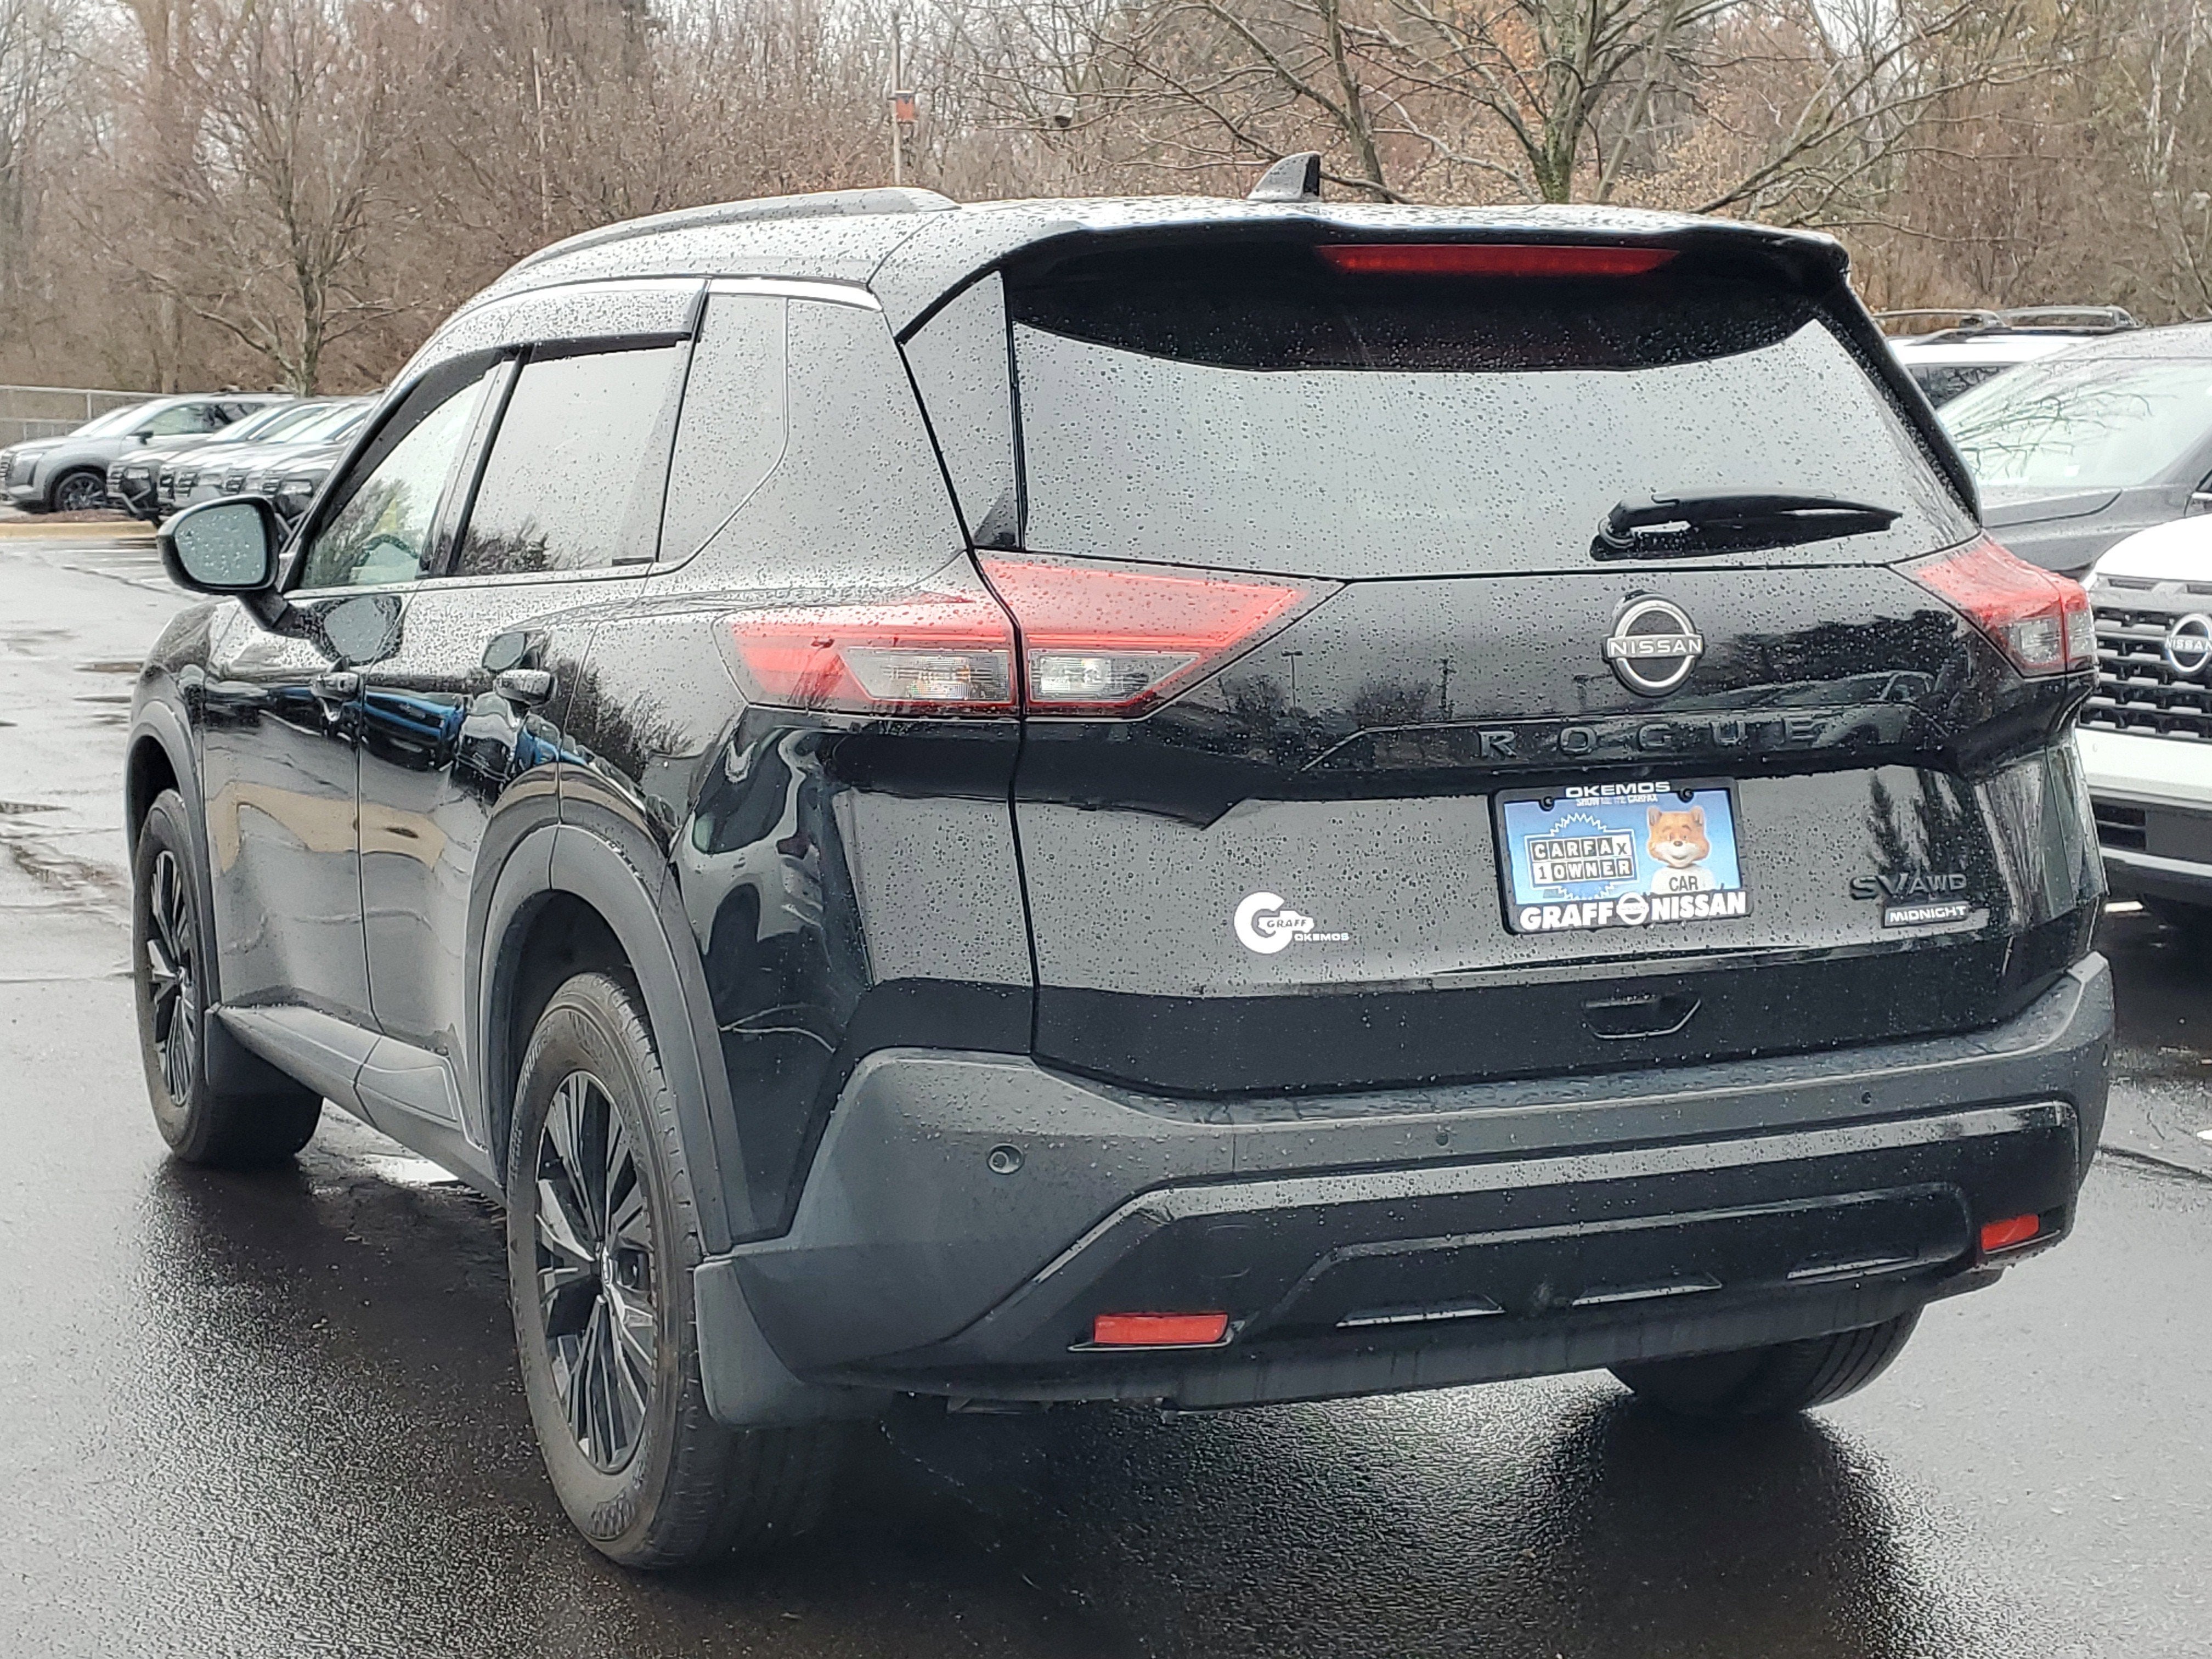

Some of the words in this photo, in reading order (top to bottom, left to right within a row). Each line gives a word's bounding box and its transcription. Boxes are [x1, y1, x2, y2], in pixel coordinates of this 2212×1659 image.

[1610, 638, 1702, 655] NISSAN
[1477, 714, 1825, 759] ROGUE
[1566, 781, 1671, 798] OKEMOS
[1534, 841, 1629, 860] CARFAX
[1538, 865, 1547, 879] 1
[1554, 860, 1630, 879] OWNER
[1669, 876, 1699, 892] CAR
[1520, 901, 1613, 930] GRAFF
[1651, 891, 1746, 921] NISSAN
[1889, 906, 1966, 922] MIDNIGHT
[1267, 919, 1307, 928] GRAFF
[1294, 933, 1350, 941] OKEMOS
